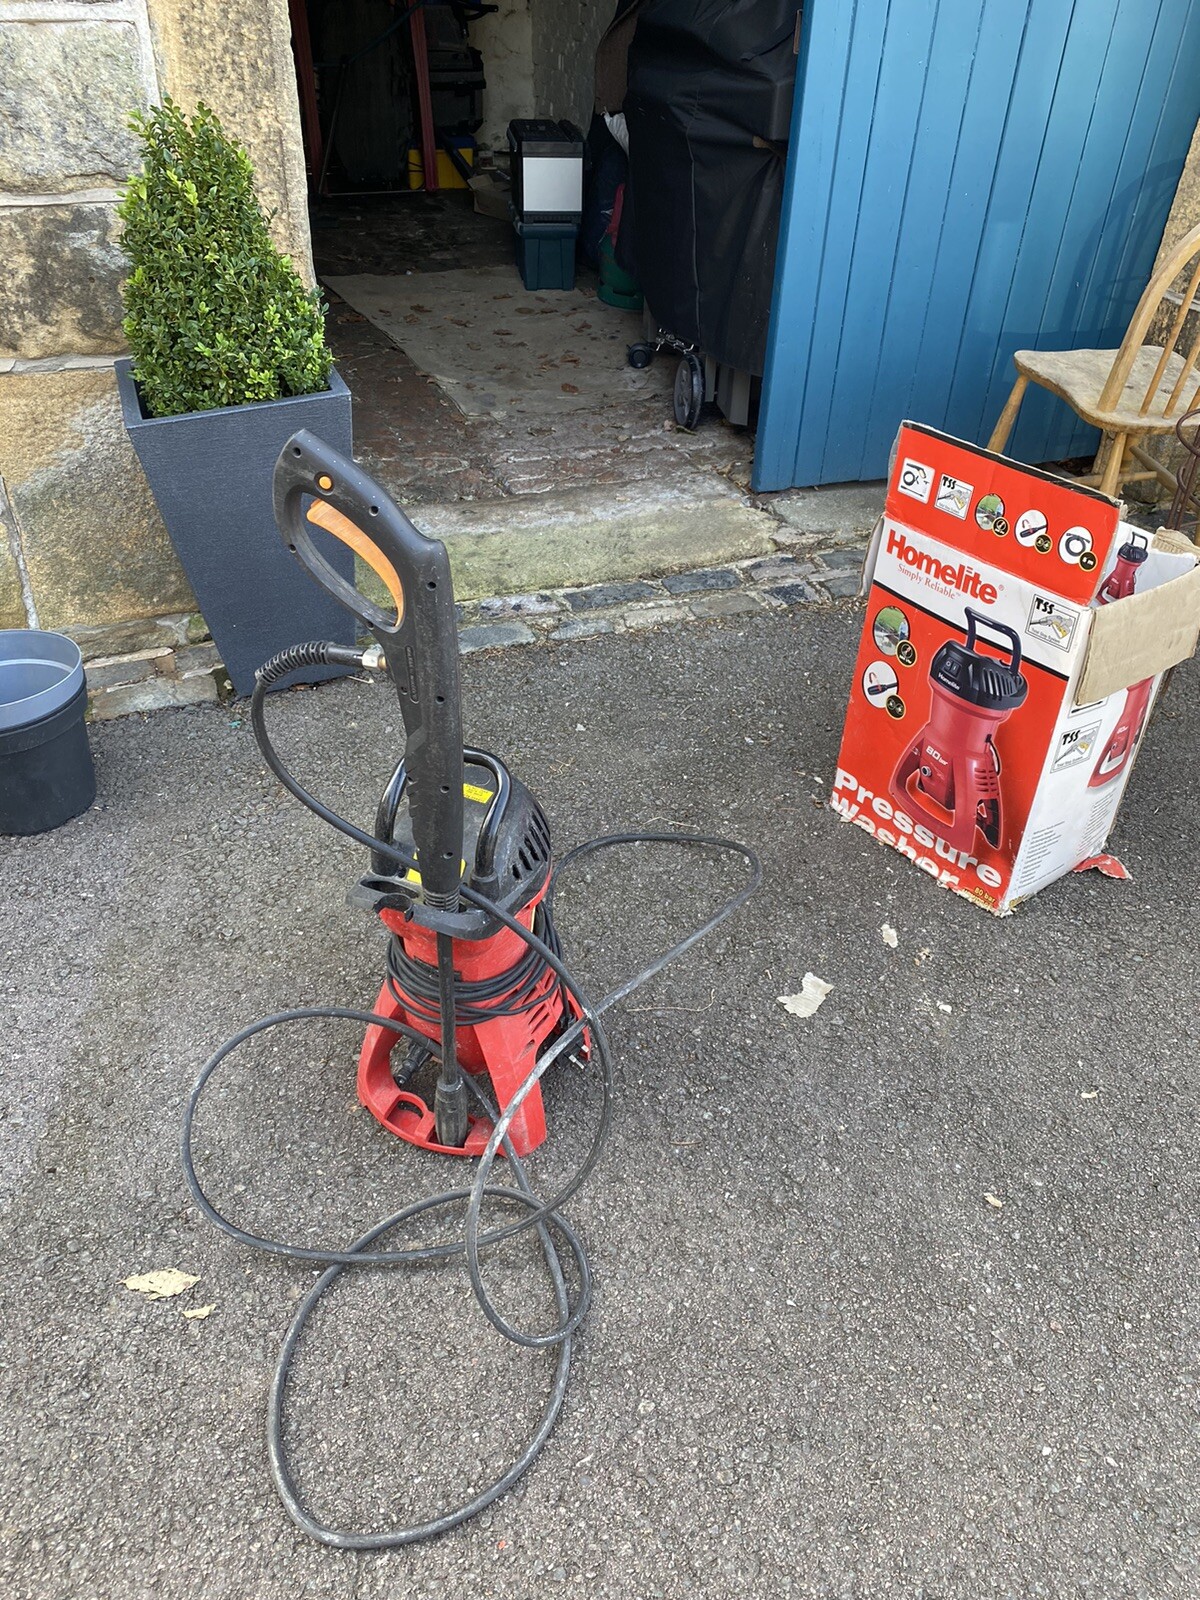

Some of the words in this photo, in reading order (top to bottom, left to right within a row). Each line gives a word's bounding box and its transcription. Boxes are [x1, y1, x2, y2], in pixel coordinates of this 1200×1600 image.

[942, 475, 957, 490] TSS
[886, 529, 998, 605] Homelite
[898, 563, 922, 584] Simply
[924, 577, 955, 600] Reliable
[1035, 597, 1055, 615] TSS
[1062, 729, 1081, 746] TSS
[834, 767, 1002, 888] Pressure
